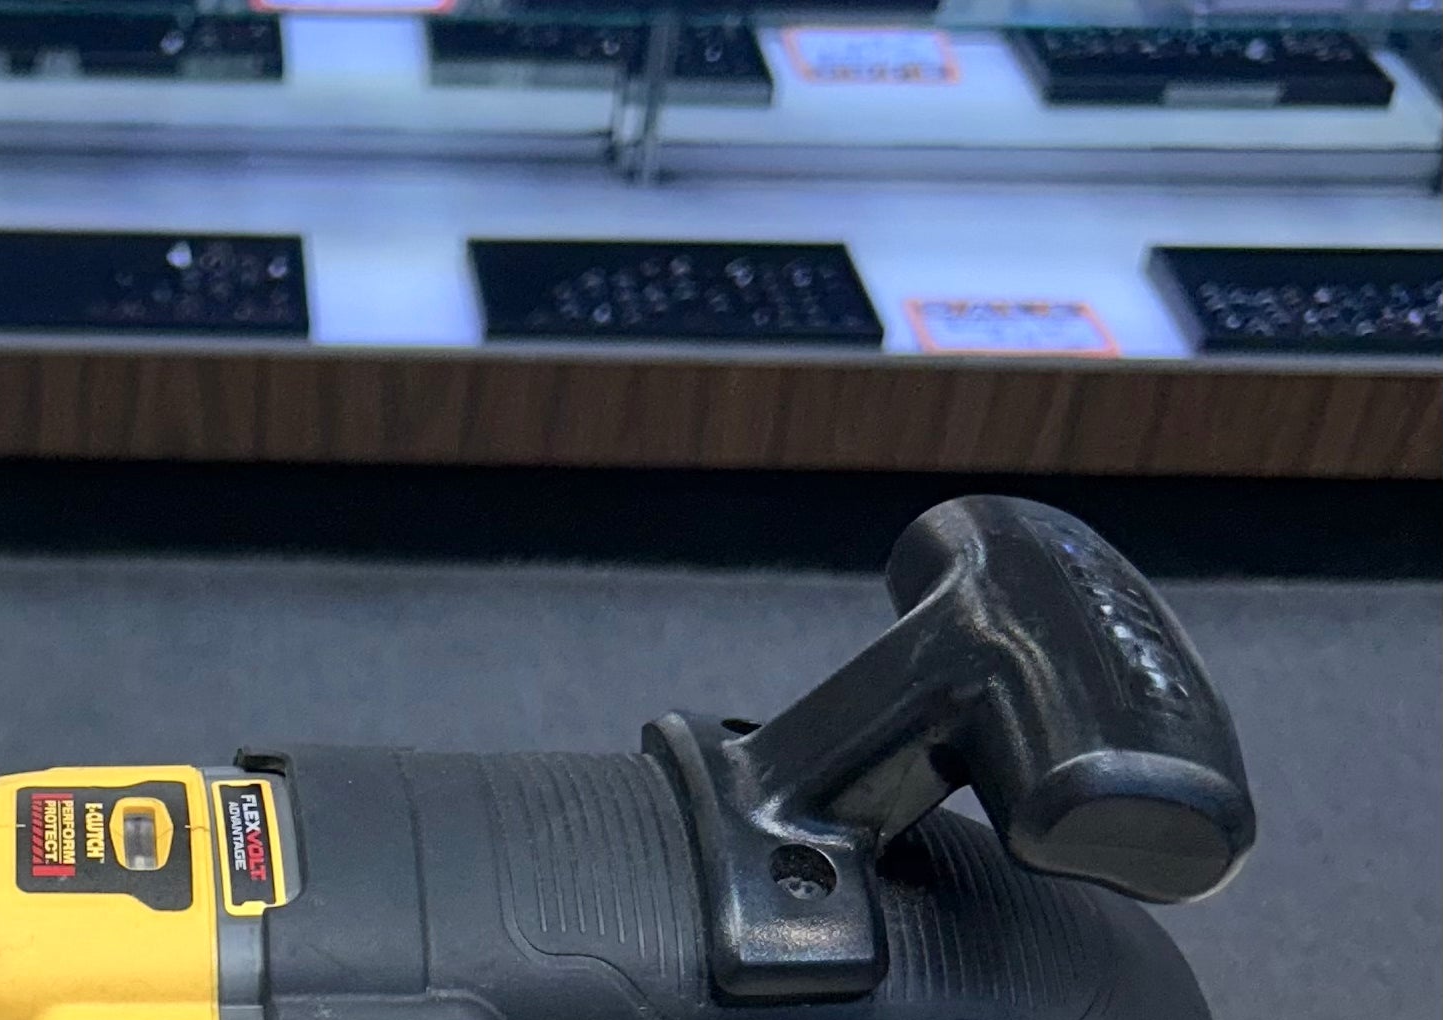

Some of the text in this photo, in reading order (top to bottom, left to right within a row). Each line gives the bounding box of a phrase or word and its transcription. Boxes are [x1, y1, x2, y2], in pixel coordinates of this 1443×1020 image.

[62, 800, 76, 864] PERFORM
[228, 801, 247, 871] ADVANTAGE
[241, 794, 266, 881] FLEXVOLT
